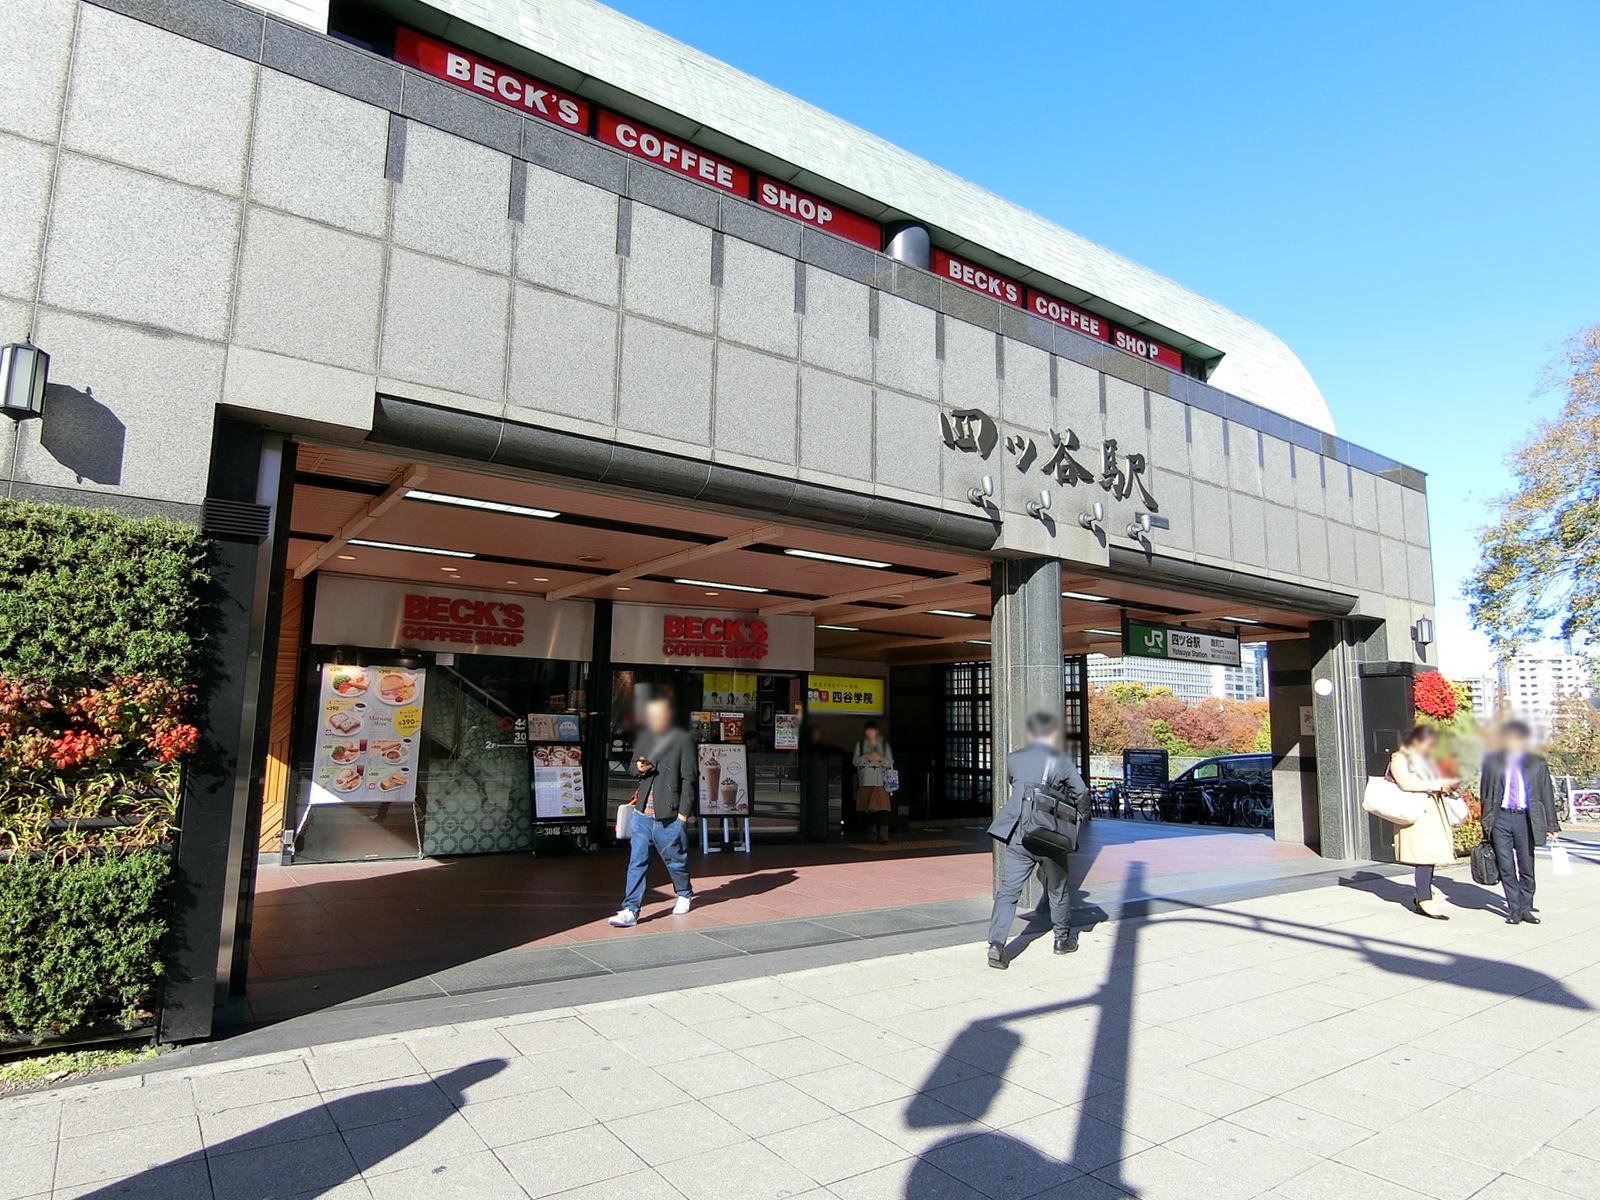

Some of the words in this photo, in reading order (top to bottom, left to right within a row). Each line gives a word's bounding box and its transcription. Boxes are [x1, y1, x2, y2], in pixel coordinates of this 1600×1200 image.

[446, 51, 580, 125] BECK'S
[615, 122, 734, 188] COFFEE
[762, 183, 833, 226] SHOP
[949, 259, 1018, 302] BECK'S
[1035, 296, 1100, 337] COFFEE
[1116, 331, 1159, 359] SHOP
[938, 408, 1159, 513] 四ツ谷駅
[404, 594, 525, 628] BECK'S
[403, 627, 472, 644] COFFEE
[475, 631, 525, 648] SHOP
[663, 615, 769, 643] BECK'S
[1144, 630, 1164, 649] JR
[1171, 633, 1201, 649] 四ツ谷駅
[663, 644, 722, 657] COFFEE
[725, 647, 768, 660] SHOP
[1172, 648, 1191, 658] Yotsuya
[1191, 650, 1208, 659] Station
[833, 692, 873, 704] 四谷学院
